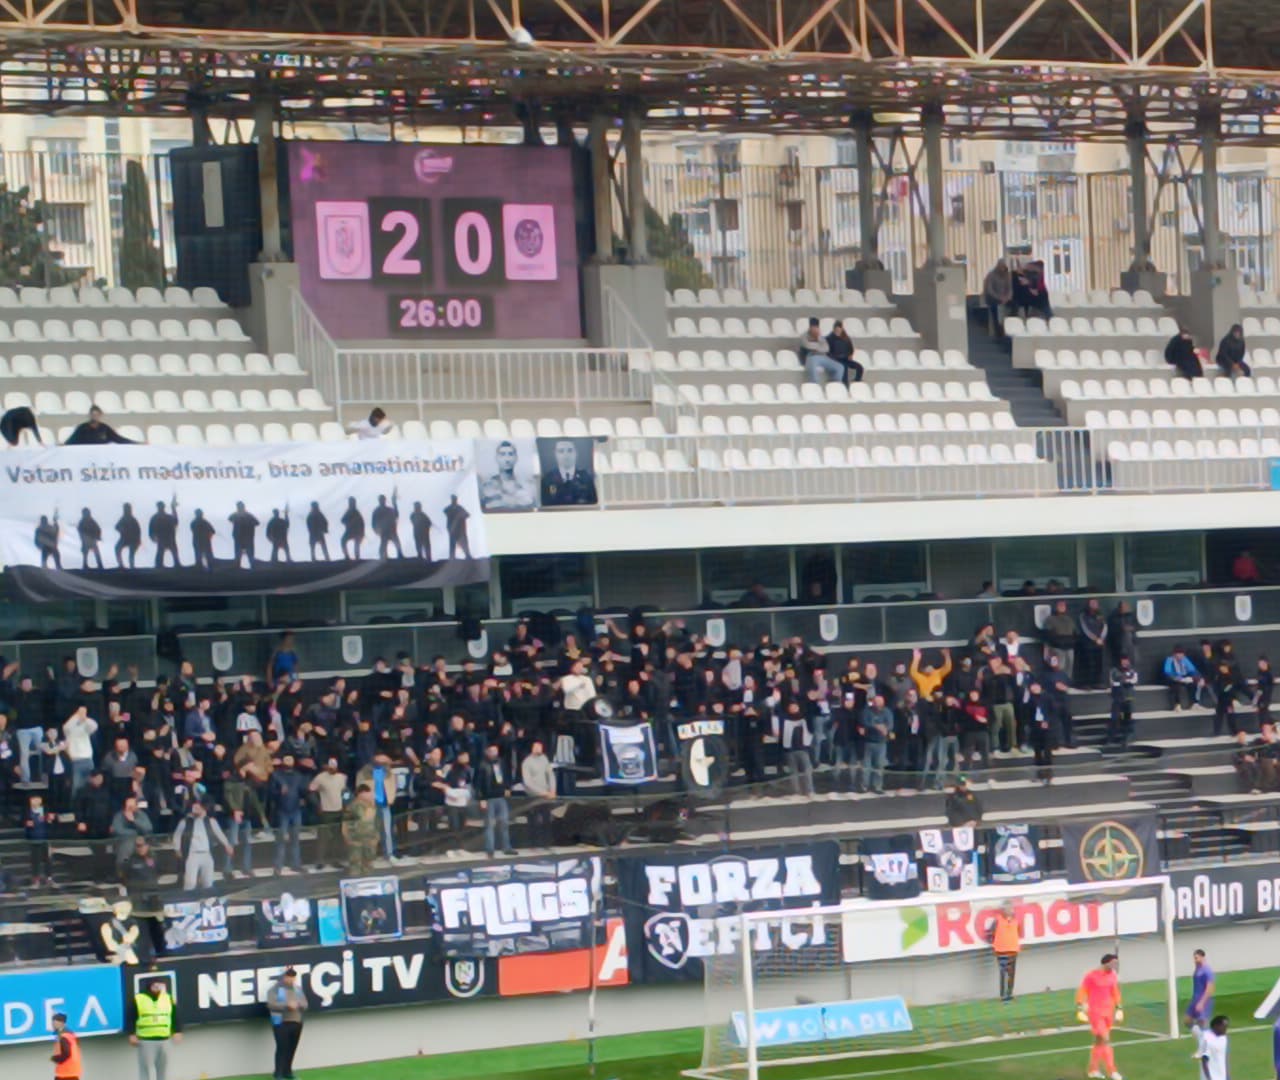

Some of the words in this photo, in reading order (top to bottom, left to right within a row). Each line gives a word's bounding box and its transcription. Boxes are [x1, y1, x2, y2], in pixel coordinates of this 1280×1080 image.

[381, 210, 421, 274] 2
[454, 211, 492, 275] 0
[399, 299, 482, 327] 26:00
[79, 461, 131, 482] sizin
[644, 855, 822, 906] FORZA
[363, 953, 425, 991] TV
